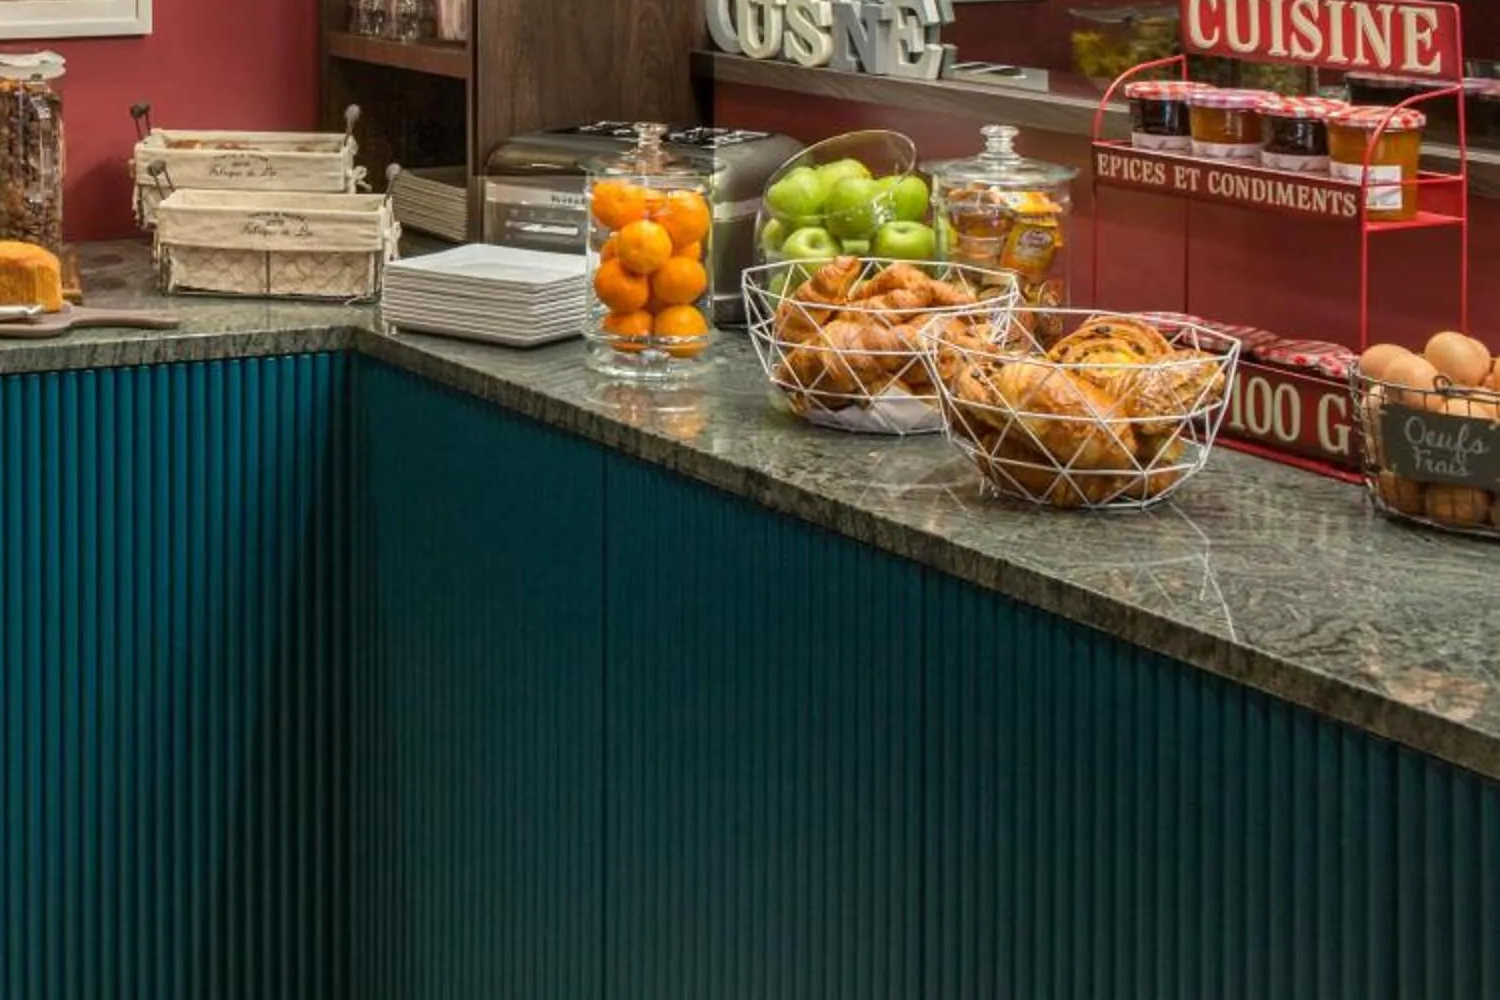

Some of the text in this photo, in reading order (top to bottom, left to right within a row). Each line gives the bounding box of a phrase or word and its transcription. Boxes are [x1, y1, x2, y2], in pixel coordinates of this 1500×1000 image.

[1097, 153, 1357, 218] EPICES ET CONDIMENTS
[1228, 372, 1351, 454] 100 G
